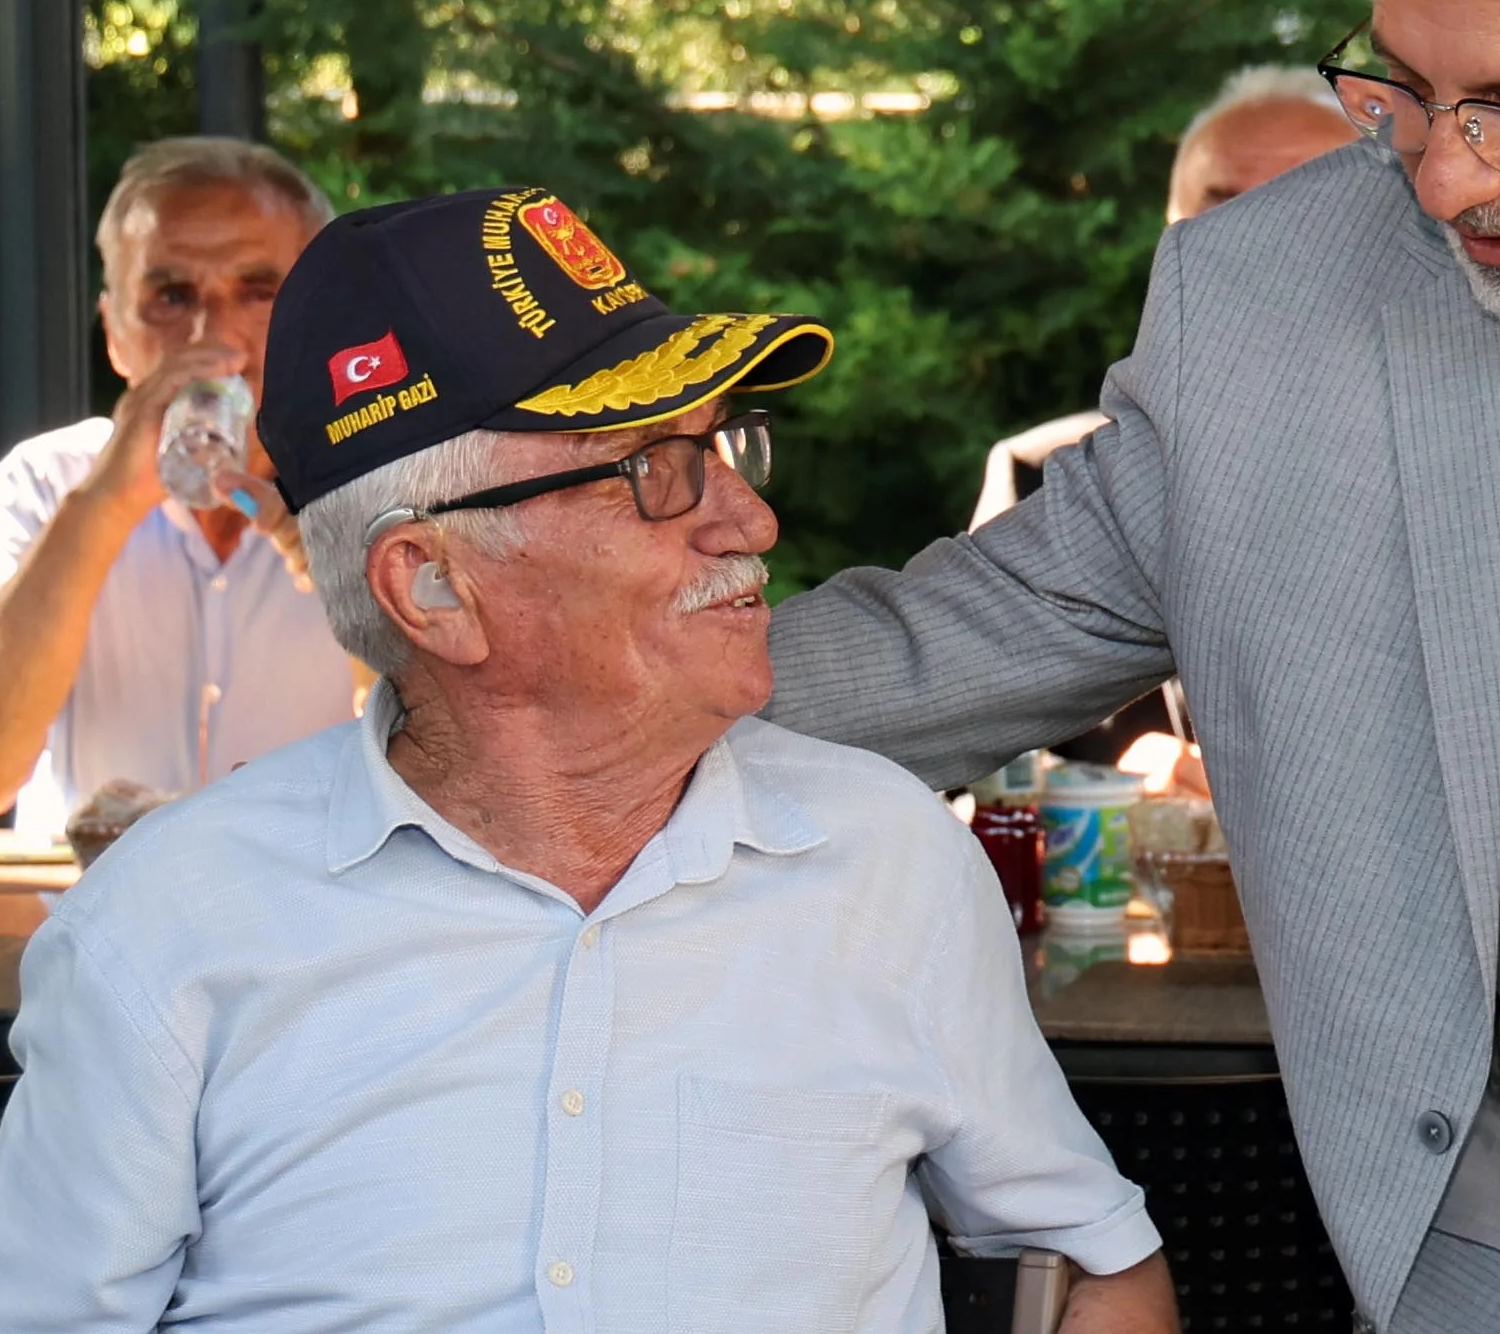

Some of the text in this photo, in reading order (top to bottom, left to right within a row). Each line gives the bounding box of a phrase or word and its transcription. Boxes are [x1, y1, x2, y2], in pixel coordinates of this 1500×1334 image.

[487, 252, 557, 339] TÜRKİYE
[325, 372, 438, 445] MUHARİP GAZİ
